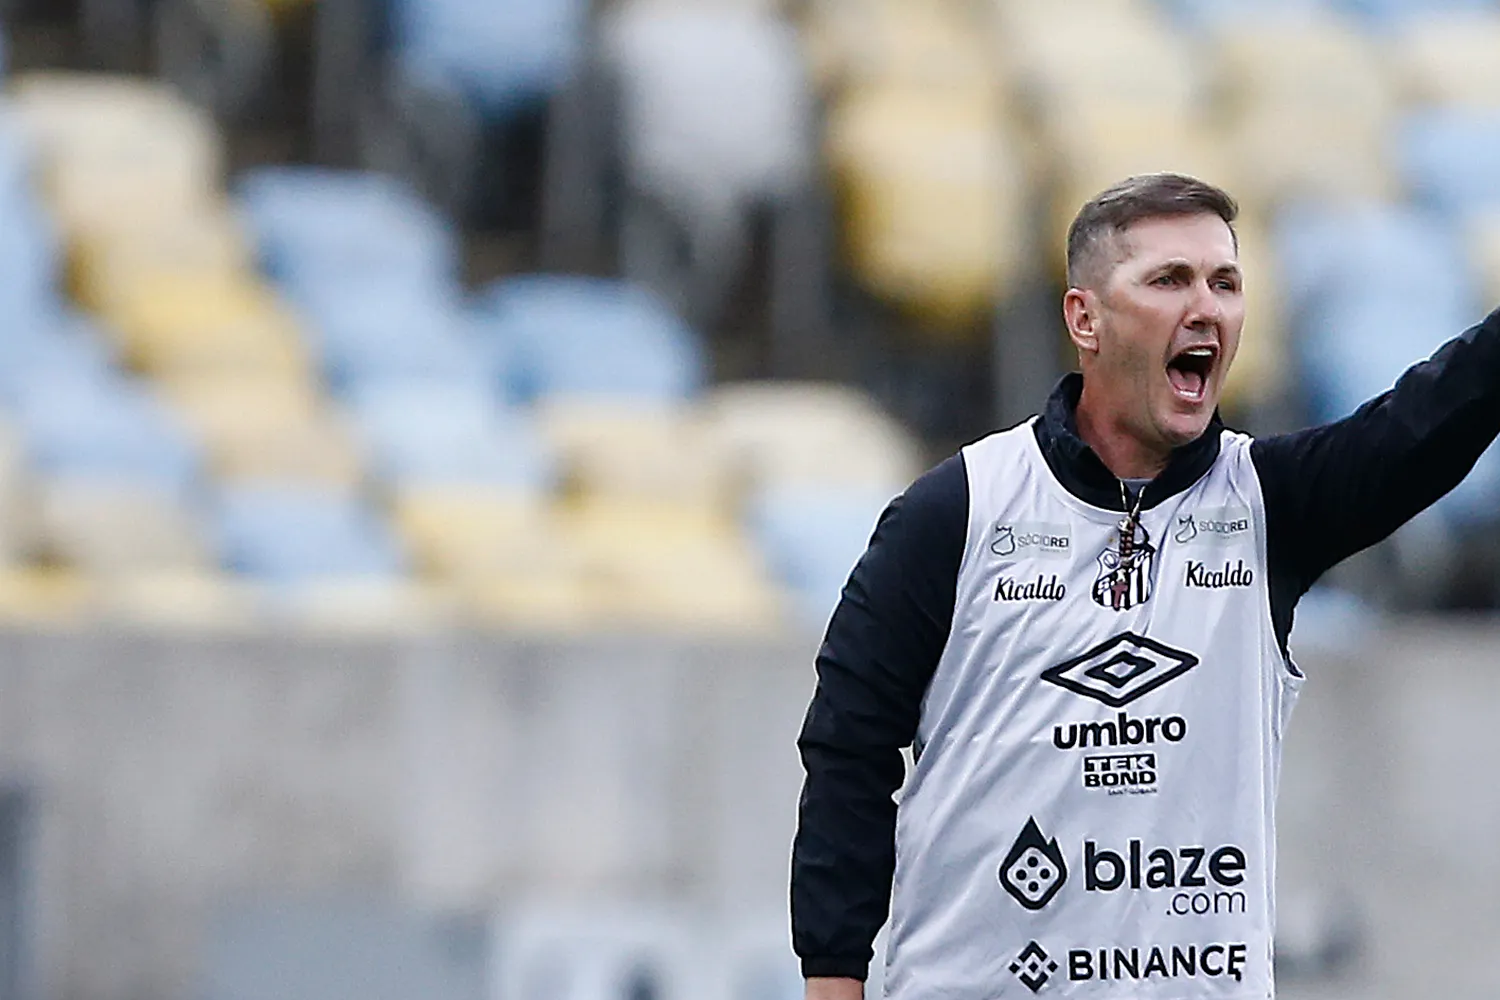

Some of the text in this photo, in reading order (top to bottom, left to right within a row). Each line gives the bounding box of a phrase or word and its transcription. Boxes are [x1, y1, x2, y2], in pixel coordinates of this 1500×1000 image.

[993, 574, 1066, 602] Kicaldo
[1185, 559, 1253, 589] Kicaldo
[1053, 712, 1187, 750] umbro
[1084, 753, 1156, 772] TEK
[1084, 771, 1157, 787] BOND
[1084, 839, 1247, 891] blaze
[1166, 891, 1246, 916] .com
[1068, 944, 1247, 982] BINANCE
